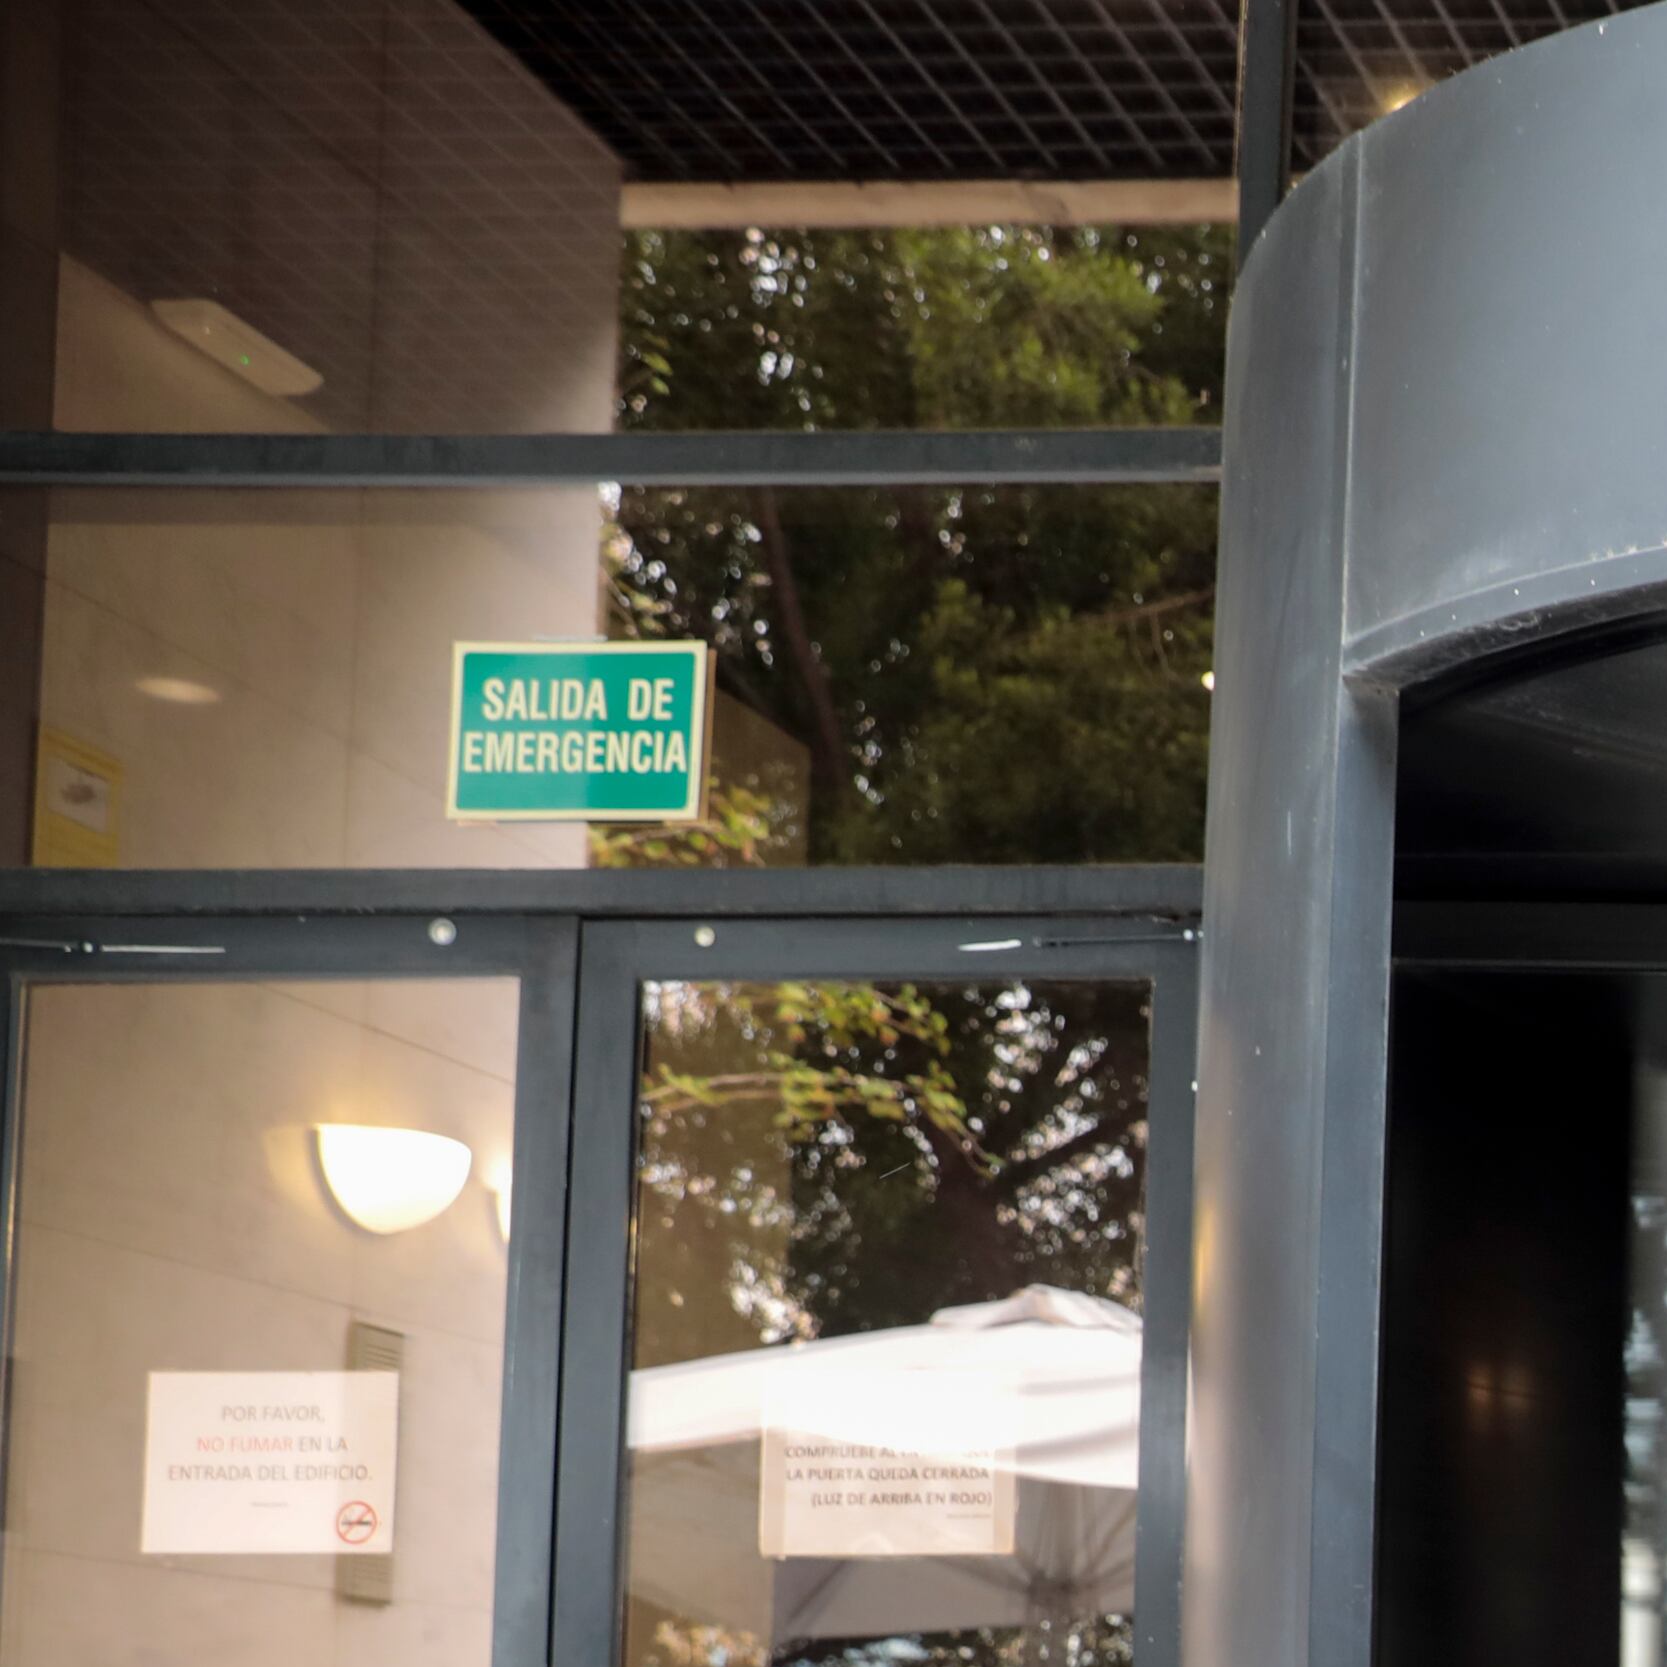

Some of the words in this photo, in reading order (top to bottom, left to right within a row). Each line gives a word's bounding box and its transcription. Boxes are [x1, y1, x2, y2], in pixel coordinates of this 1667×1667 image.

[482, 678, 607, 721] SALIDA
[627, 678, 675, 721] DE
[463, 730, 688, 773] EMERGENCIA
[221, 1405, 257, 1423] POR
[262, 1405, 325, 1424] FAVOR,
[197, 1436, 225, 1453] NO
[229, 1436, 293, 1453] FUMAR
[298, 1436, 322, 1452] EN
[327, 1436, 349, 1452] LA
[168, 1464, 253, 1482] ENTRADA
[257, 1464, 289, 1482] DEL
[294, 1464, 373, 1482] EDIFICIO.
[786, 1467, 804, 1481] LA
[807, 1467, 866, 1481] PUERTA
[868, 1467, 919, 1481] QUEDA
[921, 1466, 989, 1480] CERRADA
[847, 1492, 865, 1505] DE
[869, 1492, 922, 1505] ARRIBA
[926, 1492, 945, 1505] EN
